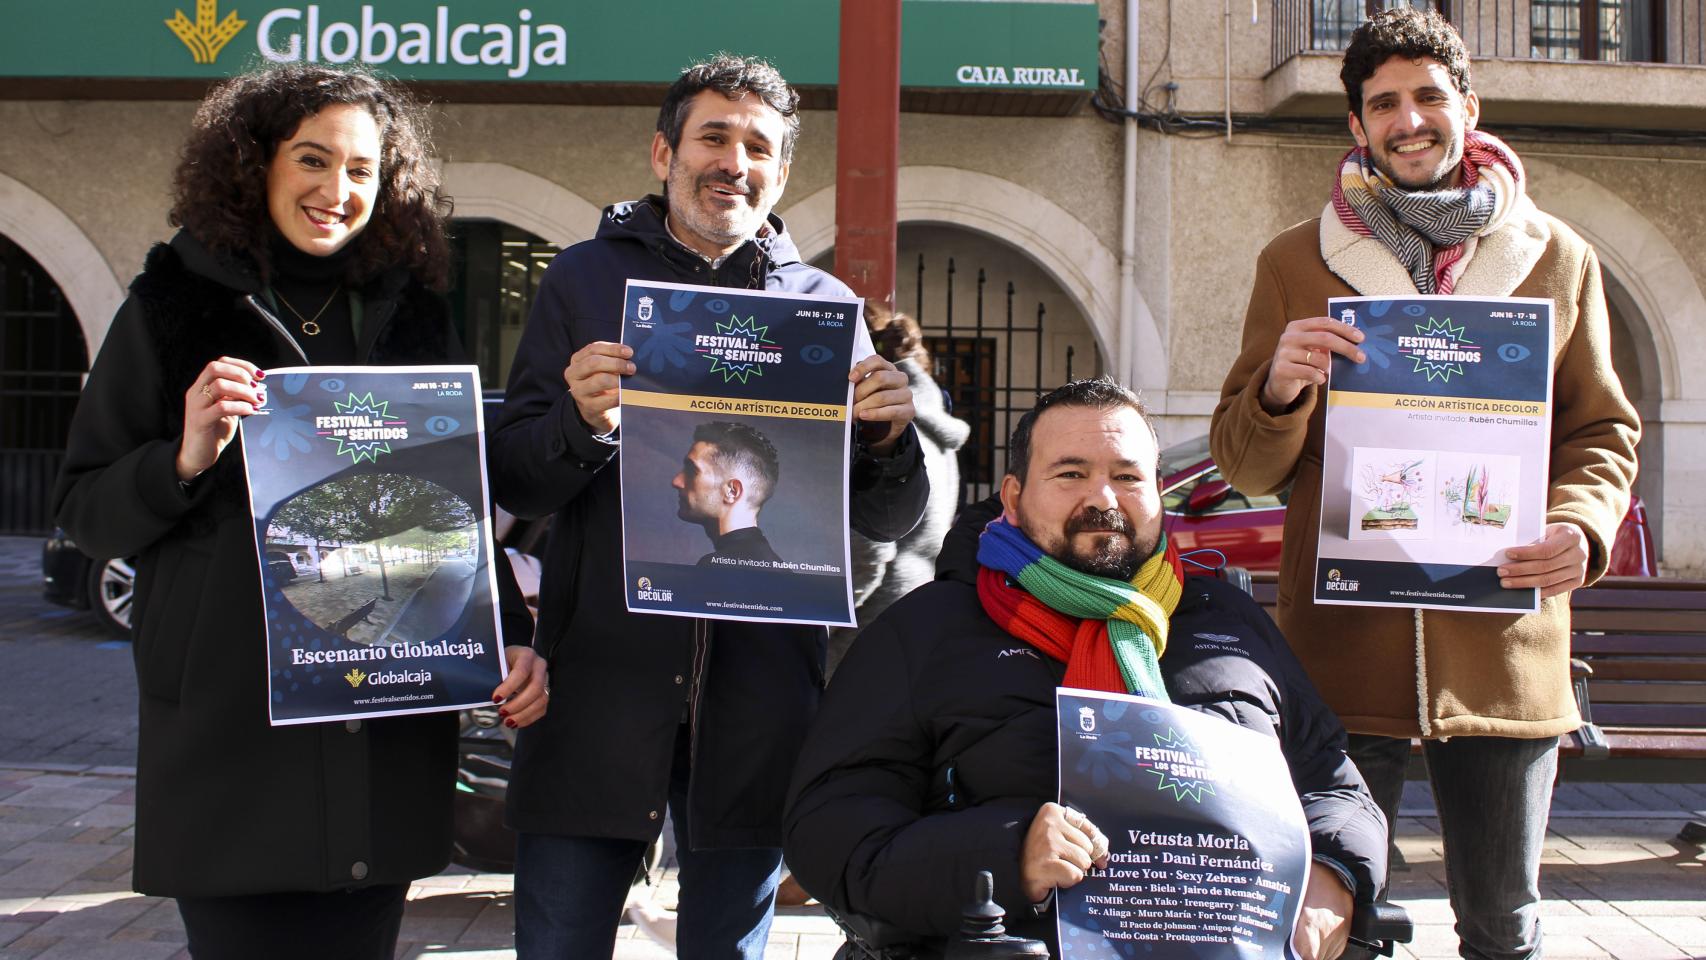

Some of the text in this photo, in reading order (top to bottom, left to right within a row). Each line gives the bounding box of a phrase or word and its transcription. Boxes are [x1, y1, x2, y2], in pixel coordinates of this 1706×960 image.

[256, 5, 566, 78] Globalcaja
[956, 66, 1085, 86] CAJA RURAL
[795, 310, 811, 318] JUN
[836, 312, 845, 320] 18
[1506, 311, 1513, 319] 16
[1529, 312, 1537, 320] 18
[695, 335, 749, 350] FESTIVAL
[1397, 336, 1448, 350] FESTIVAL
[710, 348, 782, 364] LOS SENTIDOS
[1426, 350, 1481, 363] SENTIDOS
[690, 399, 839, 418] ACCIÓN ARTÍSTICA DECOLOR
[1394, 398, 1539, 414] ACCIÓN ARTÍSTICA DECOLOR
[316, 416, 384, 429] FESTIVAL DE
[1407, 413, 1433, 421] Artista
[1469, 416, 1495, 425] Rubén
[1496, 417, 1538, 427] Chumillas
[333, 428, 408, 441] LOS SENTIDOS
[711, 556, 737, 566] Artista
[772, 560, 799, 571] Rubén
[800, 562, 841, 573] Chumillas
[1389, 589, 1466, 600] www.festivalsentidos.com
[706, 601, 783, 612] www.festivalsentidos.com
[291, 638, 485, 665] Escenario Globalcaja
[367, 669, 432, 686] Globalcaja
[353, 692, 434, 705] www.festivalsentidos.com
[1135, 746, 1194, 765] FESTIVAL
[1154, 761, 1170, 771] LOS
[1128, 829, 1250, 851] Vetusta Morla
[1162, 851, 1197, 866] Dani
[1199, 854, 1275, 873] Fernández
[1091, 866, 1107, 878] La
[1109, 867, 1140, 878] Love
[1142, 868, 1168, 879] You
[1176, 870, 1203, 884] Sexy
[1205, 872, 1248, 885] Zebras
[1255, 875, 1291, 894] Amatria
[1109, 882, 1267, 902] Maren Biela Jairo de Remache
[1085, 895, 1124, 905] INNMIR
[1130, 896, 1153, 906] Cora
[1154, 897, 1178, 906] Yako
[1184, 899, 1235, 911] Irenegarry
[1088, 907, 1101, 915] Sr.
[1103, 908, 1132, 919] Aliaga
[1138, 909, 1163, 918] Muro
[1164, 909, 1192, 919] María
[1198, 911, 1214, 919] For
[1215, 912, 1238, 921] Your
[1129, 921, 1151, 929] Pacto
[1163, 922, 1197, 930] Johnson
[1202, 923, 1231, 933] Amigos
[1102, 929, 1132, 939] Nando
[1133, 932, 1159, 940] Costa
[1165, 932, 1228, 944] Protagonistas
